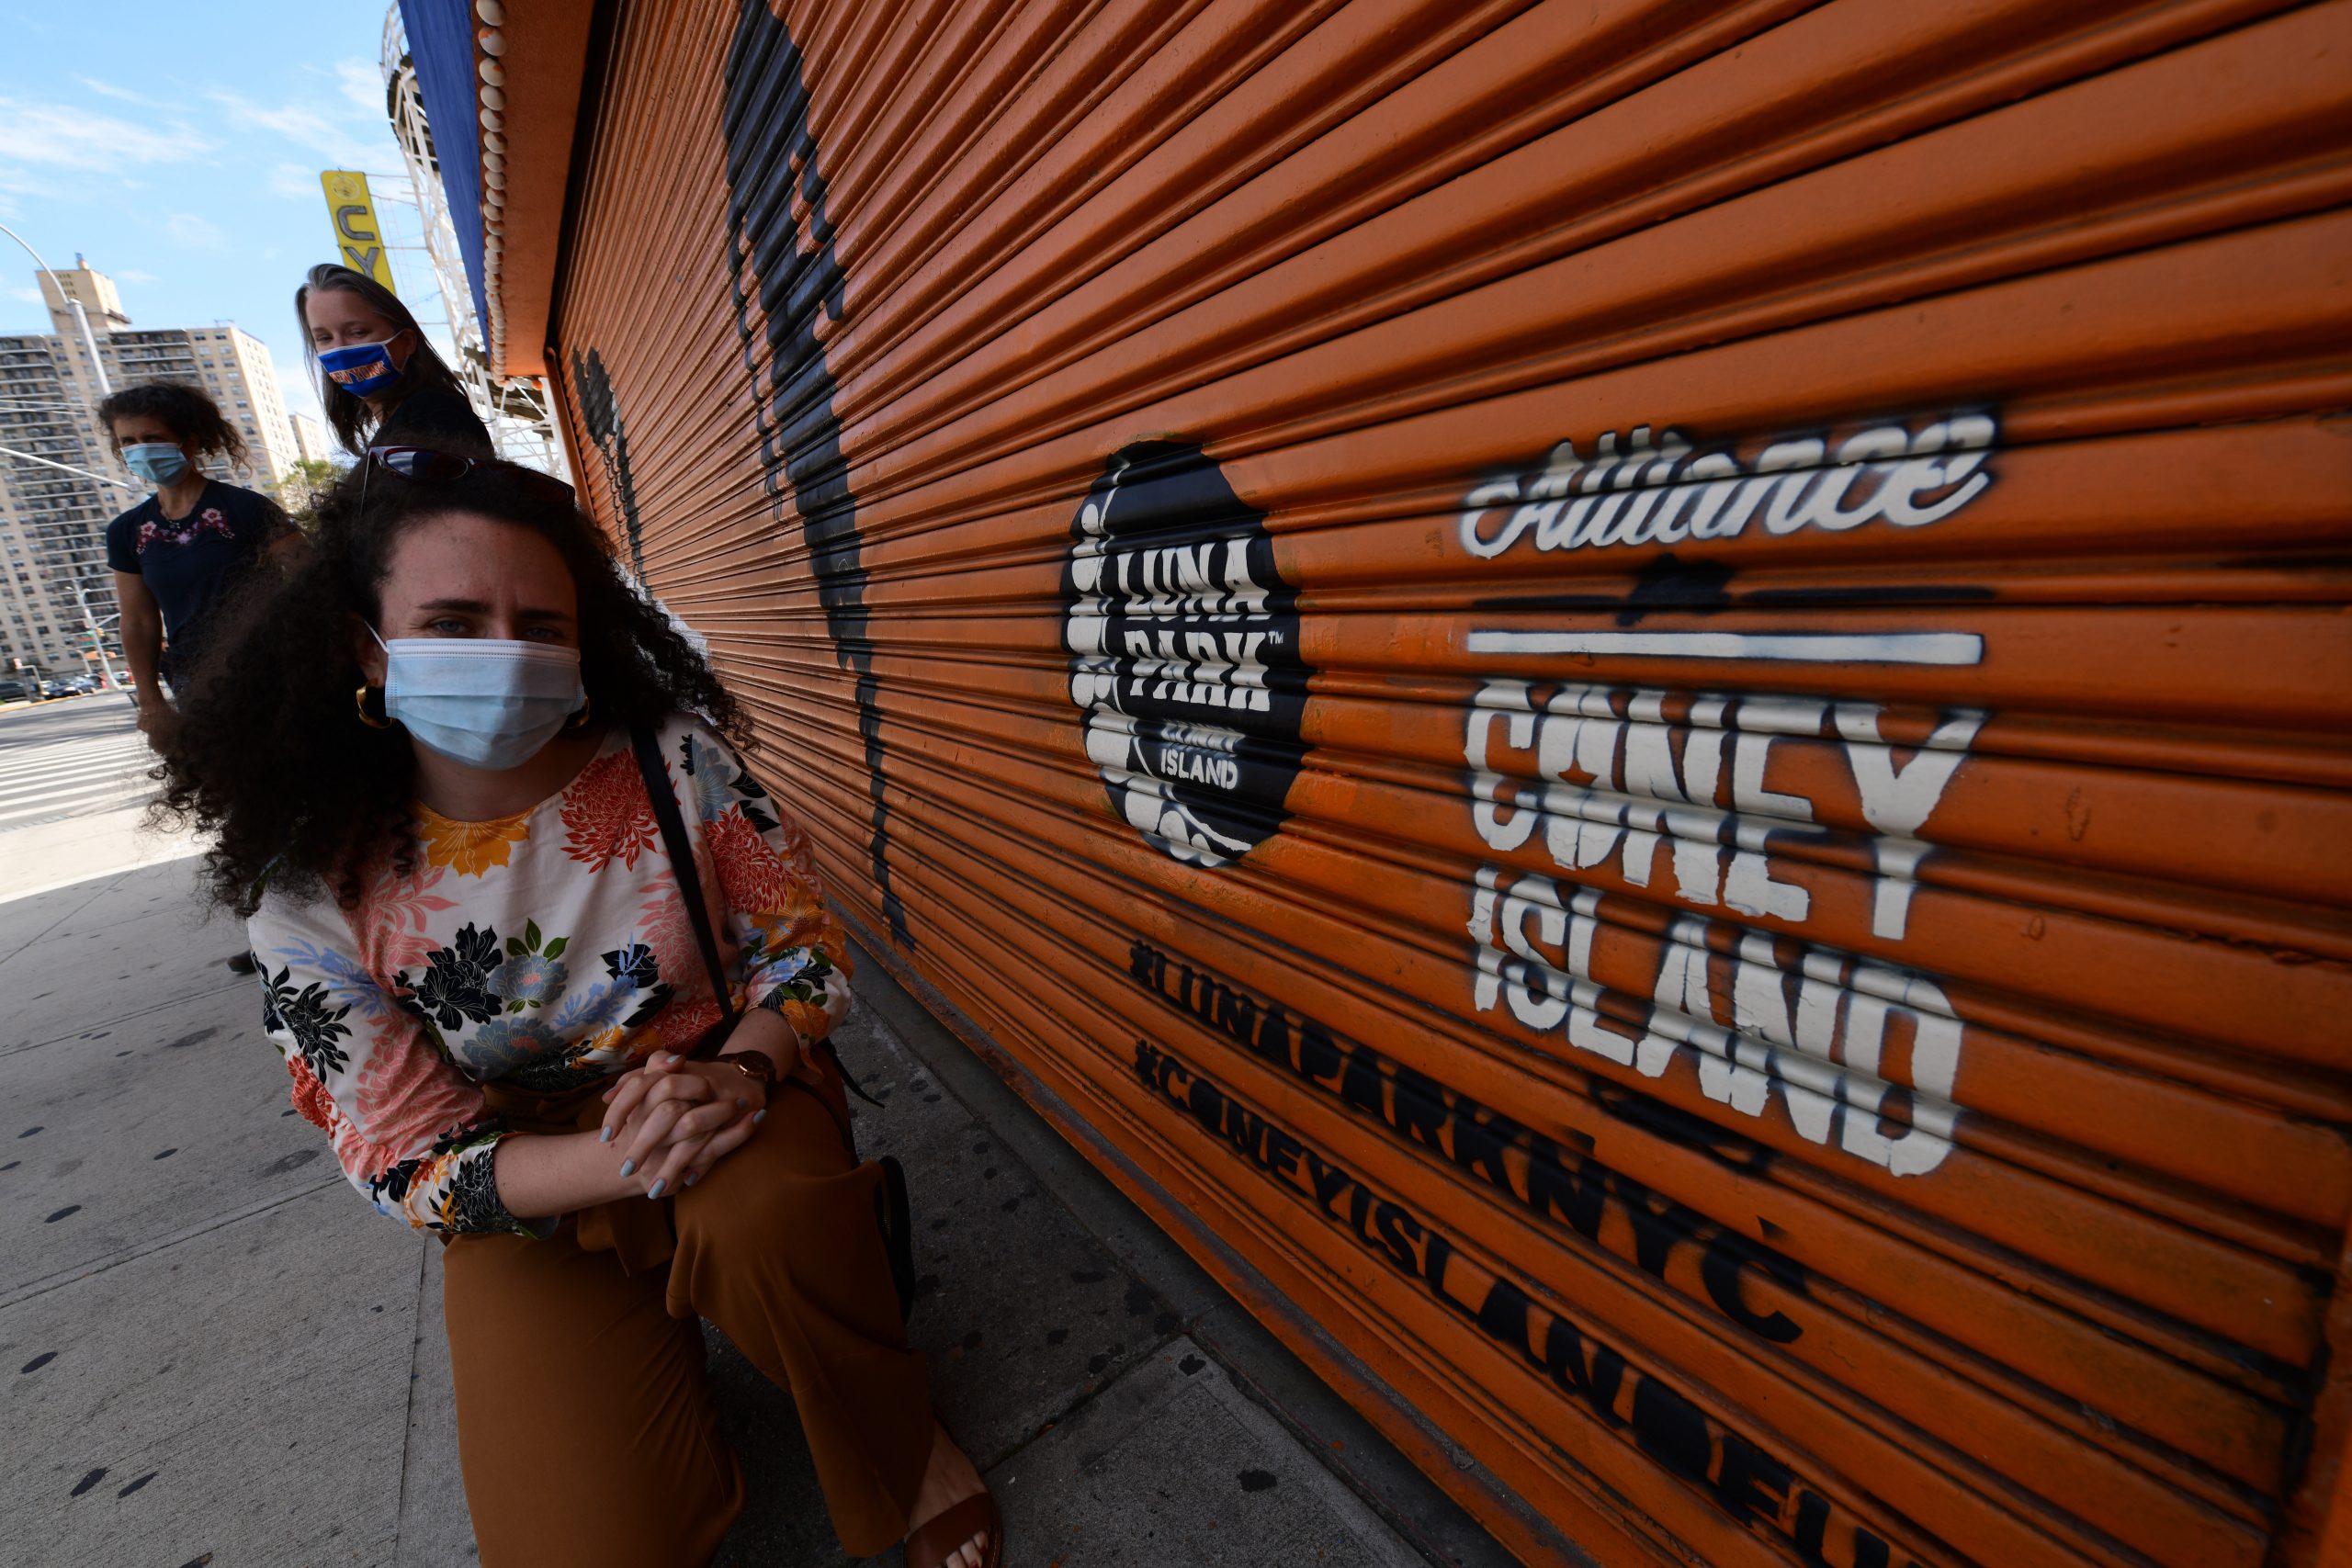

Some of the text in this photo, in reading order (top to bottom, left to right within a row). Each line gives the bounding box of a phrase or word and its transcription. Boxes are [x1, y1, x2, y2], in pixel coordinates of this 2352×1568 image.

[1460, 413, 1997, 558] Alliance
[1117, 537, 1272, 621] LUNA
[1160, 748, 1238, 790] ISLAND
[1464, 679, 1995, 943] CONEY
[1465, 864, 1966, 1179] ISLAND
